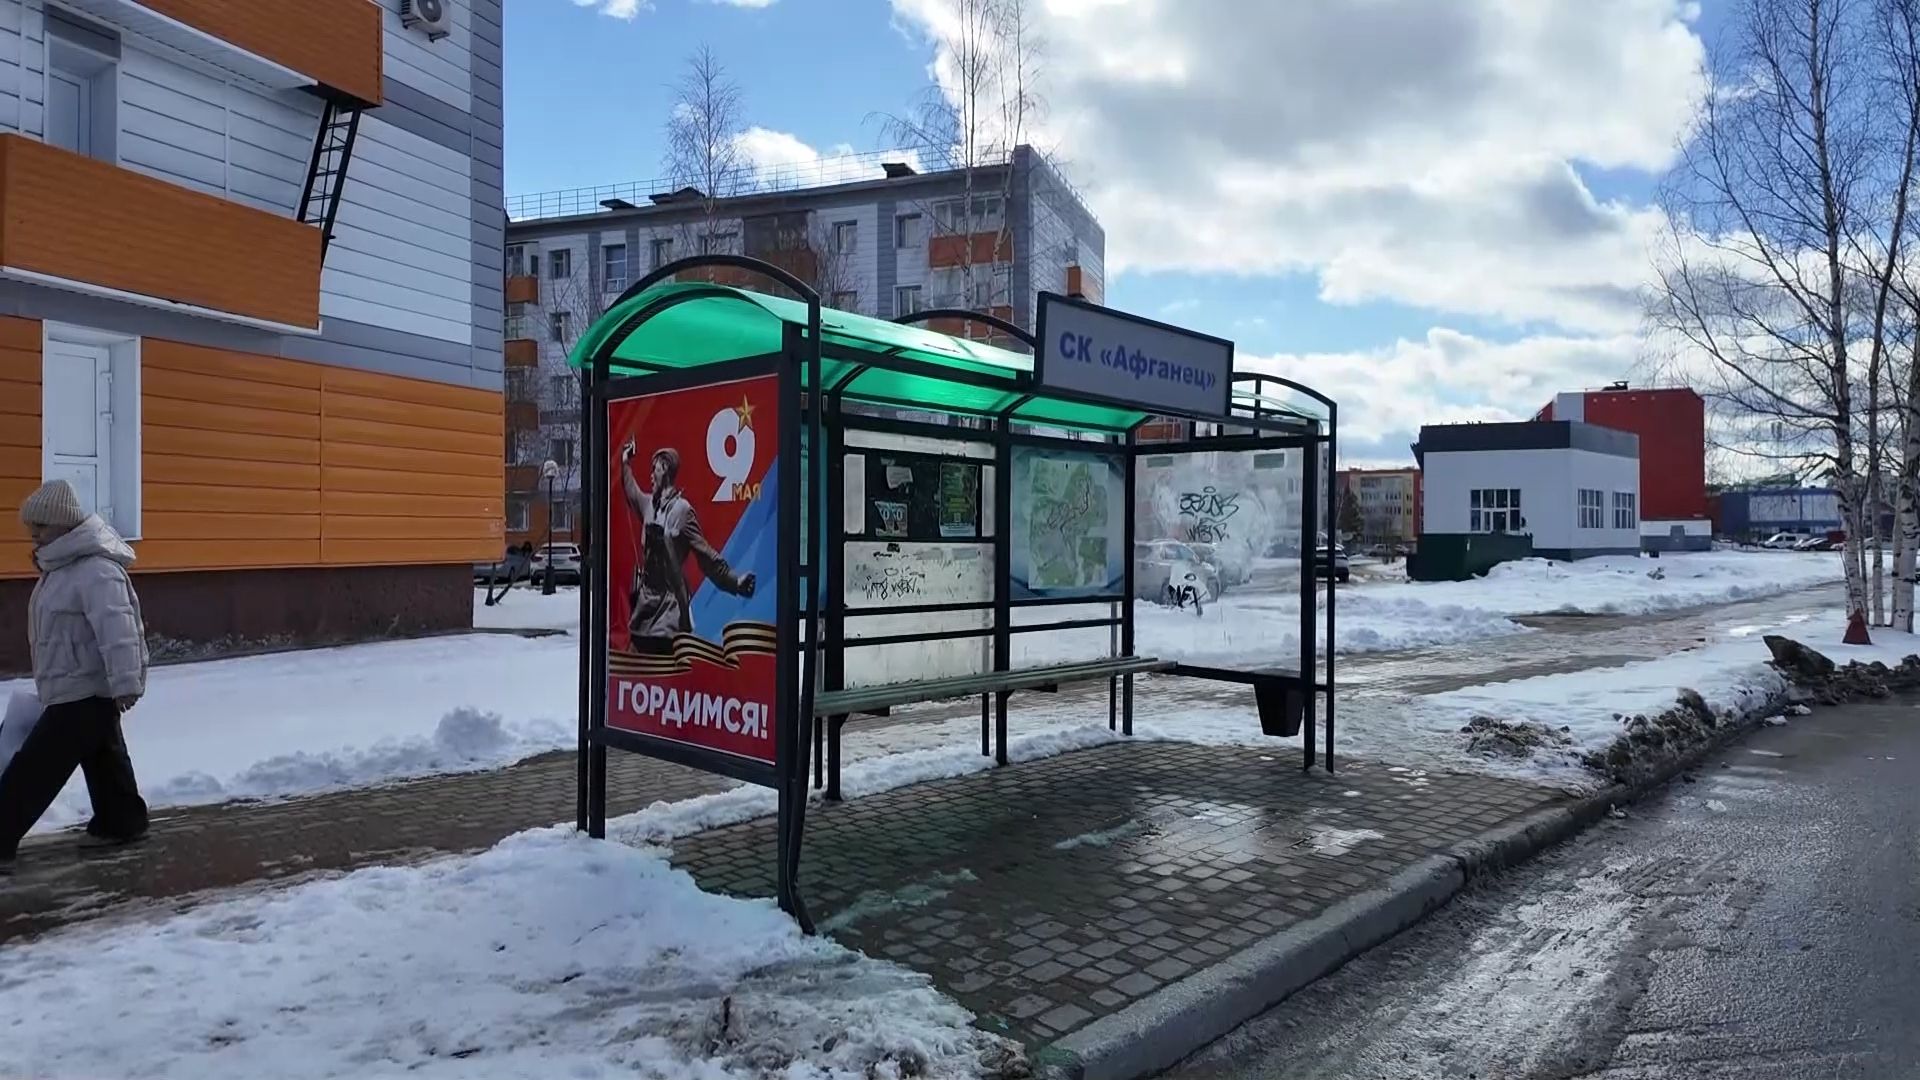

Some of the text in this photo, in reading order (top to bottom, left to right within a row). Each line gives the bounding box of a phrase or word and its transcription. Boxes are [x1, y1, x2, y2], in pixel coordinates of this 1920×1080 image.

[1059, 331, 1216, 391] СК «Афганец»
[706, 407, 756, 502] 9
[731, 482, 761, 502] МАЯ
[617, 680, 769, 740] ГОРДИМСЯ!
